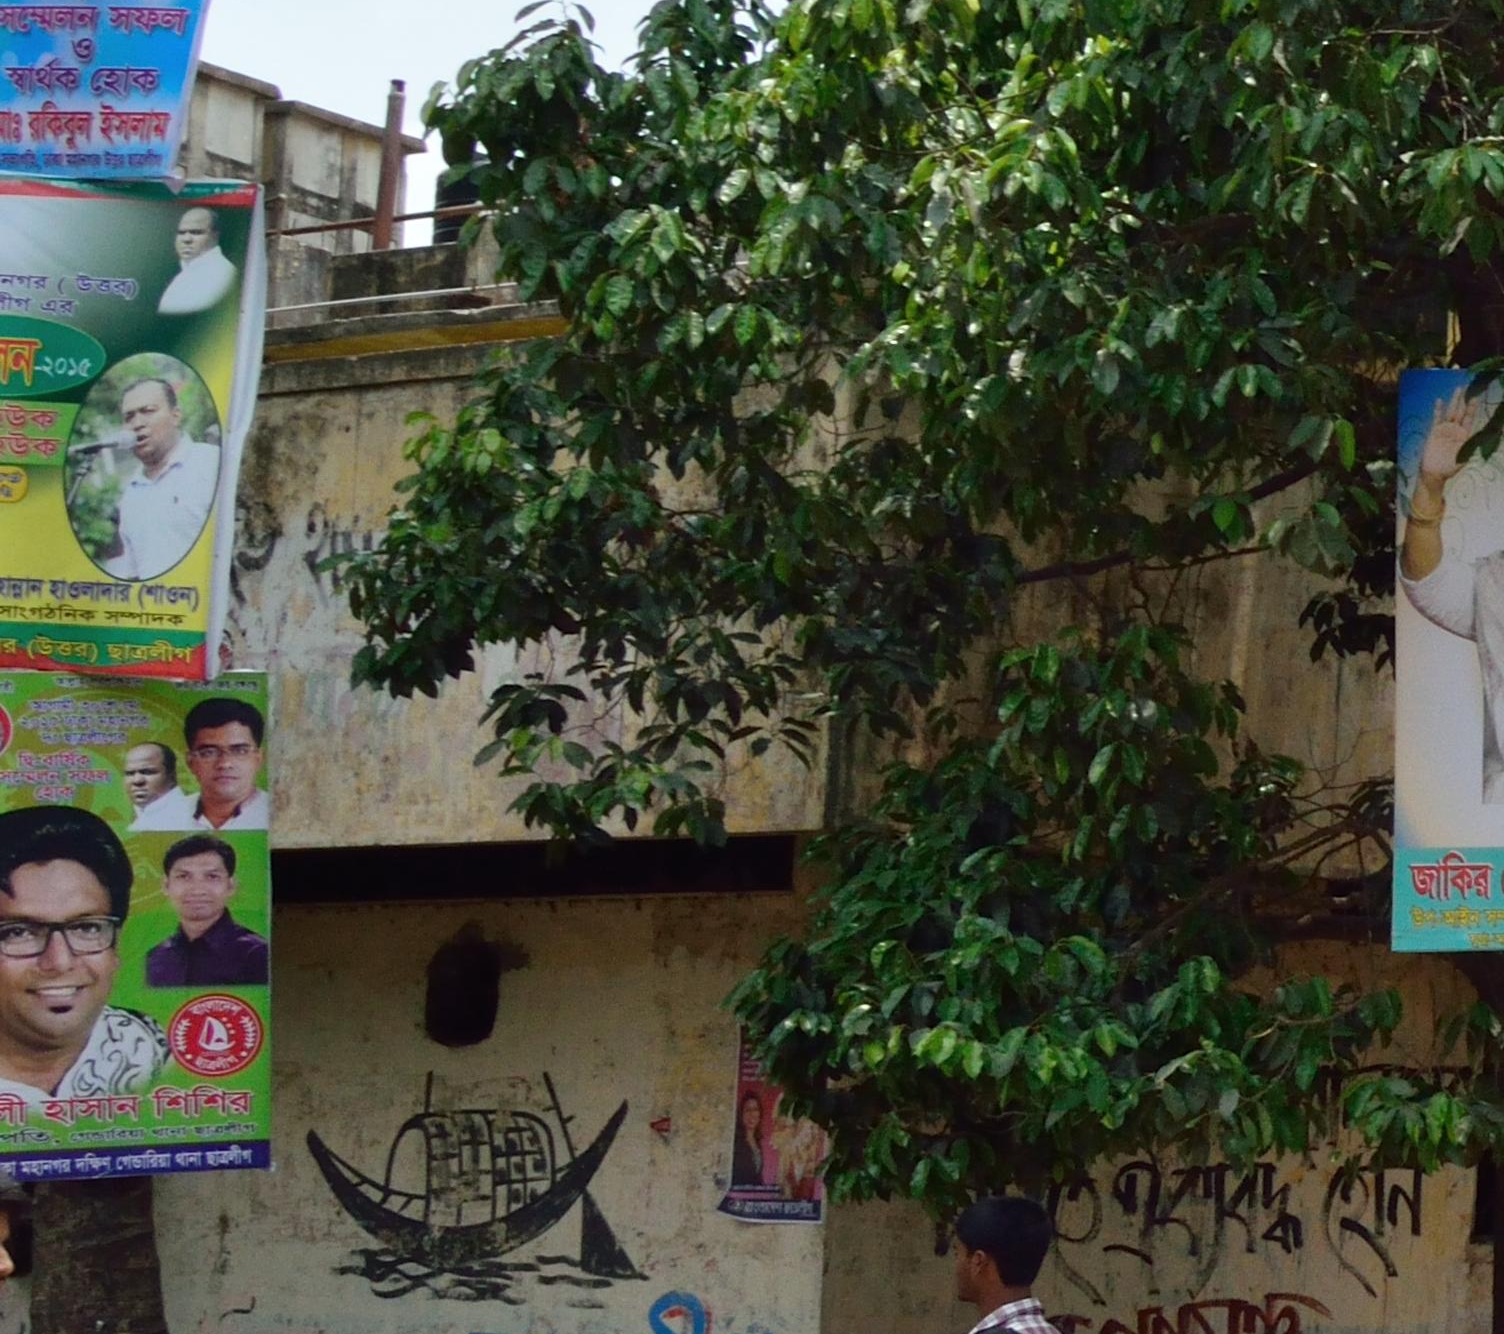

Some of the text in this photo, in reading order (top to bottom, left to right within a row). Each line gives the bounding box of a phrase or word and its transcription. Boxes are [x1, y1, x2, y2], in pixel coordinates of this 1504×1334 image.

[109, 7, 190, 36] সফল
[72, 38, 94, 63] ও
[90, 67, 160, 96] হোক
[99, 103, 172, 143] ইসলাম
[107, 639, 194, 664] ছাত্রলীগ
[1409, 850, 1493, 901] জাকির
[40, 1094, 141, 1127] হাসান
[152, 1085, 254, 1118] শিশির
